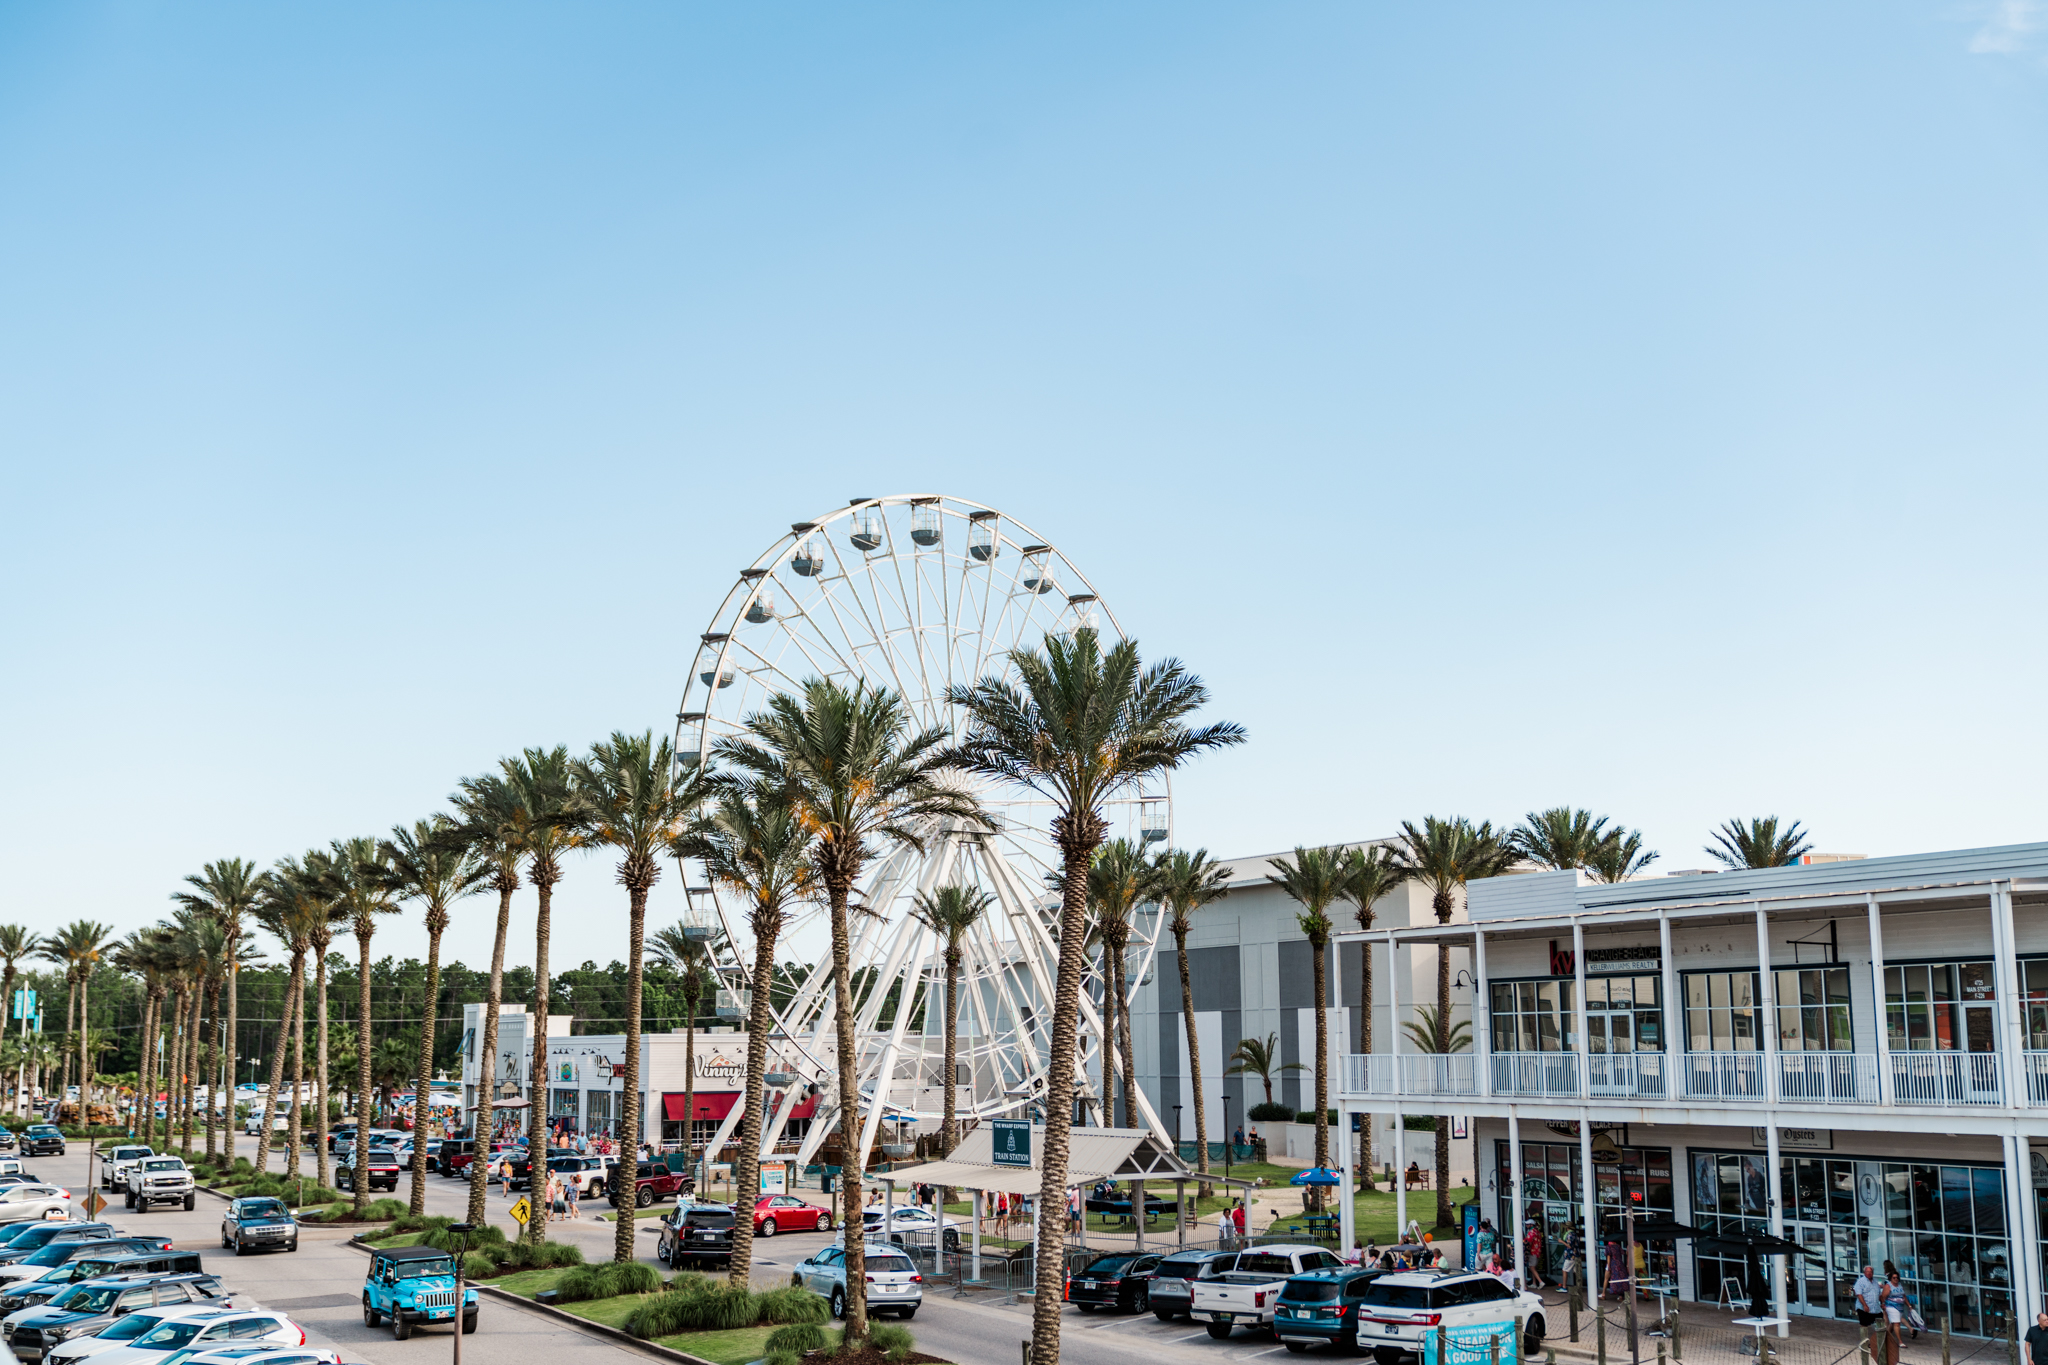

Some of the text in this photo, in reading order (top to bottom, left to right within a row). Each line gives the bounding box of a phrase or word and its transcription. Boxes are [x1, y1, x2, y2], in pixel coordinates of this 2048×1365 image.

[1586, 946, 1658, 961] ORANGE BEACH
[1631, 961, 1655, 970] REALTY
[692, 1054, 748, 1086] Vinny's
[1545, 1119, 1569, 1128] PEPPER
[1783, 1128, 1815, 1141] Oysters
[994, 1152, 1029, 1162] TRAIN STATION
[1525, 1161, 1544, 1169] SALSA
[1597, 1166, 1605, 1174] BBQ
[1649, 1169, 1670, 1177] RUBS
[1630, 1191, 1642, 1201] PEN
[1458, 1334, 1492, 1349] READY
[1498, 1331, 1513, 1344] OR
[1452, 1350, 1482, 1364] GOOD
[1484, 1346, 1508, 1361] TIE
